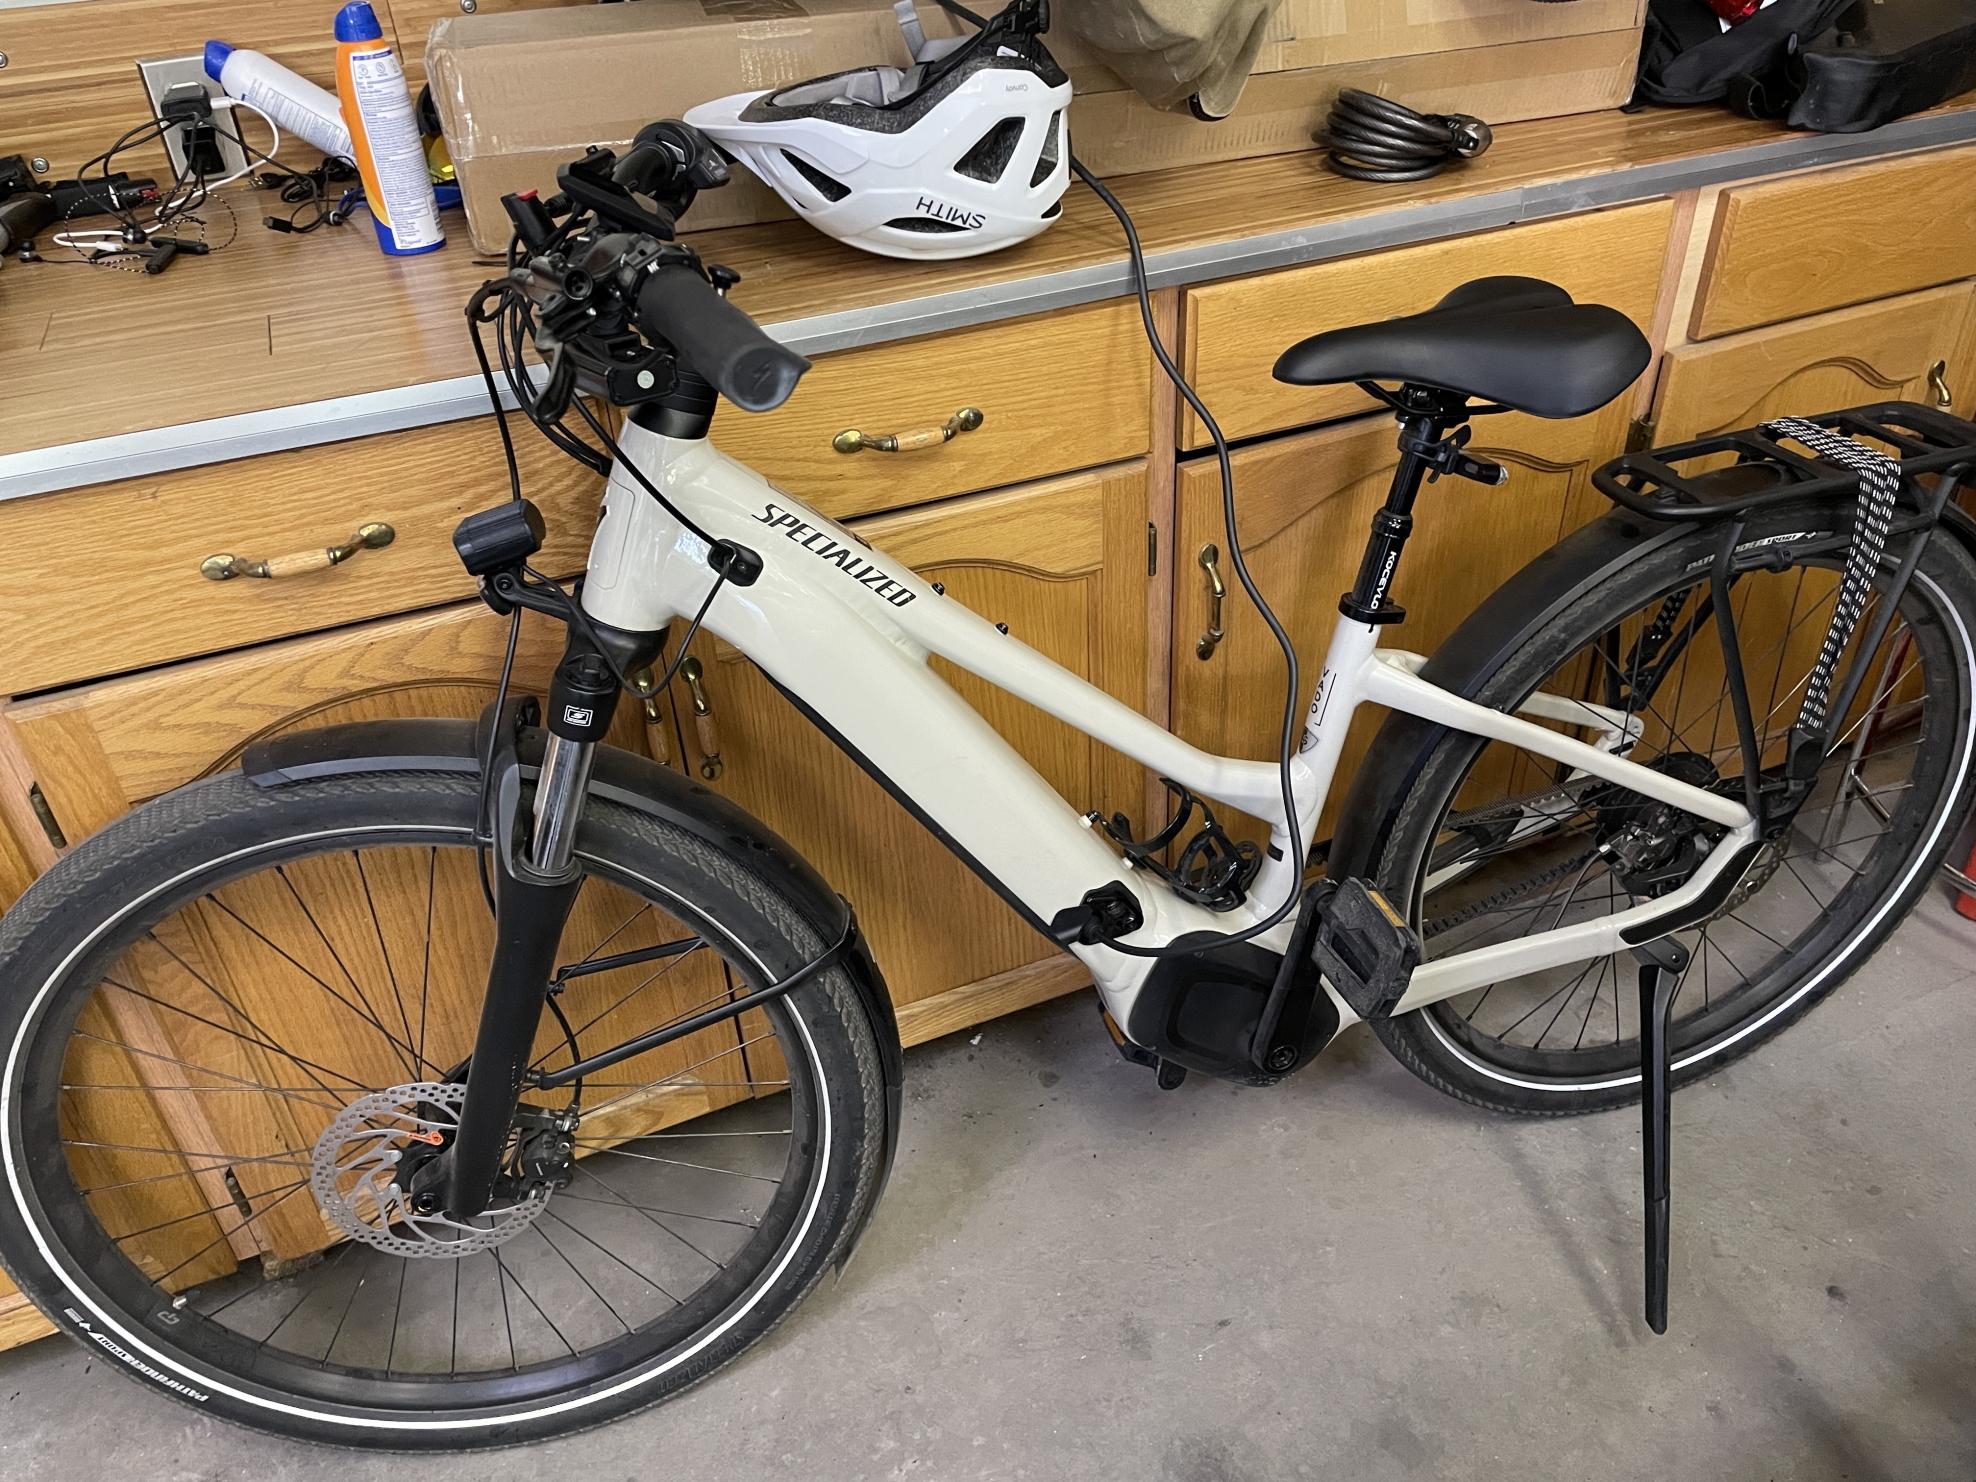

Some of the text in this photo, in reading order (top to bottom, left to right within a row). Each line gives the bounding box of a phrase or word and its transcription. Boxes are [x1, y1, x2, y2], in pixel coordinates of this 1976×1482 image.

[915, 196, 986, 229] SMITH
[751, 503, 917, 607] SPECIALIZED
[1371, 551, 1397, 610] KOCEVLO
[97, 1336, 209, 1402] PATHFINDER SPORT
